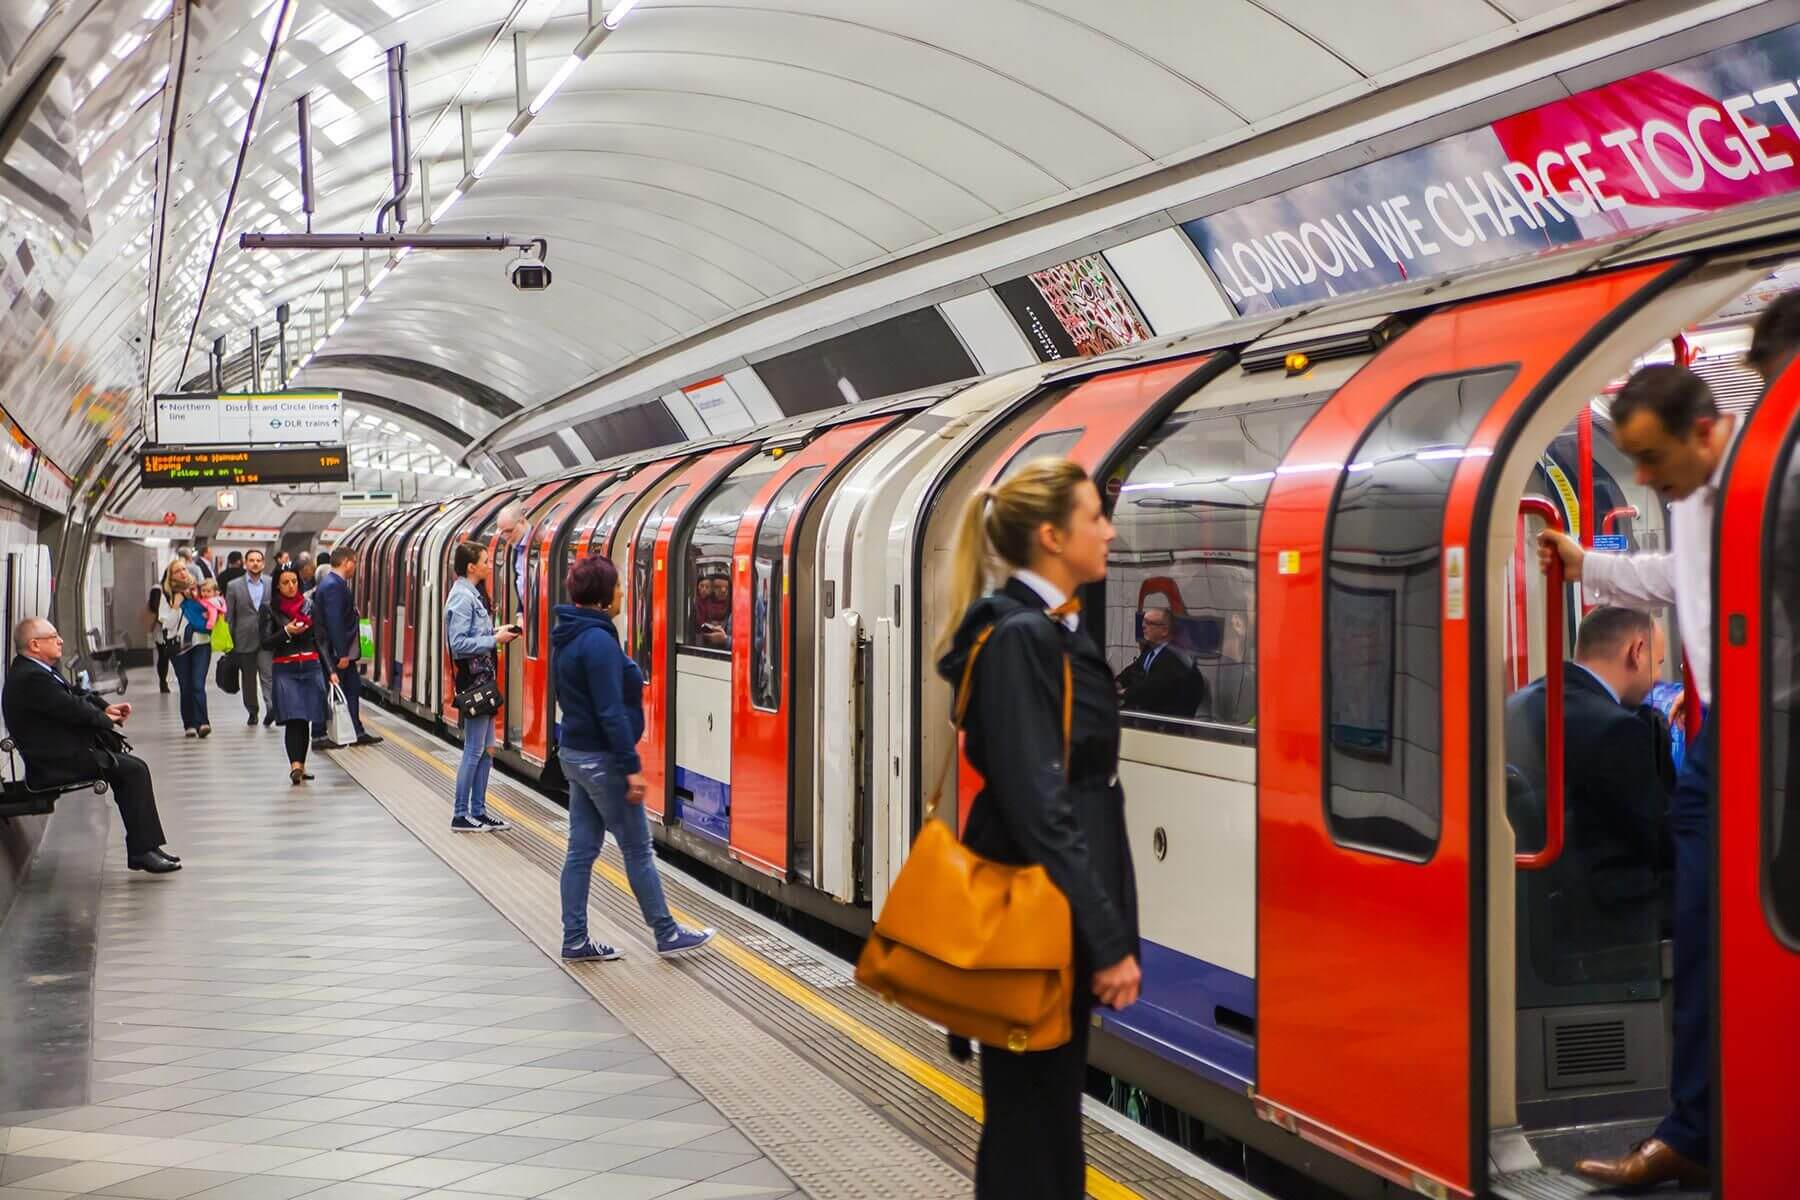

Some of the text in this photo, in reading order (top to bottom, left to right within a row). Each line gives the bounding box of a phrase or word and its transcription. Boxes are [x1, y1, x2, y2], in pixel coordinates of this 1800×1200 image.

[1214, 80, 1800, 297] LONDON WE CHARGE TOGET
[169, 403, 211, 411] Northern
[225, 401, 330, 412] District and Circle lines
[169, 413, 186, 421] line
[284, 418, 330, 428] DLR trains
